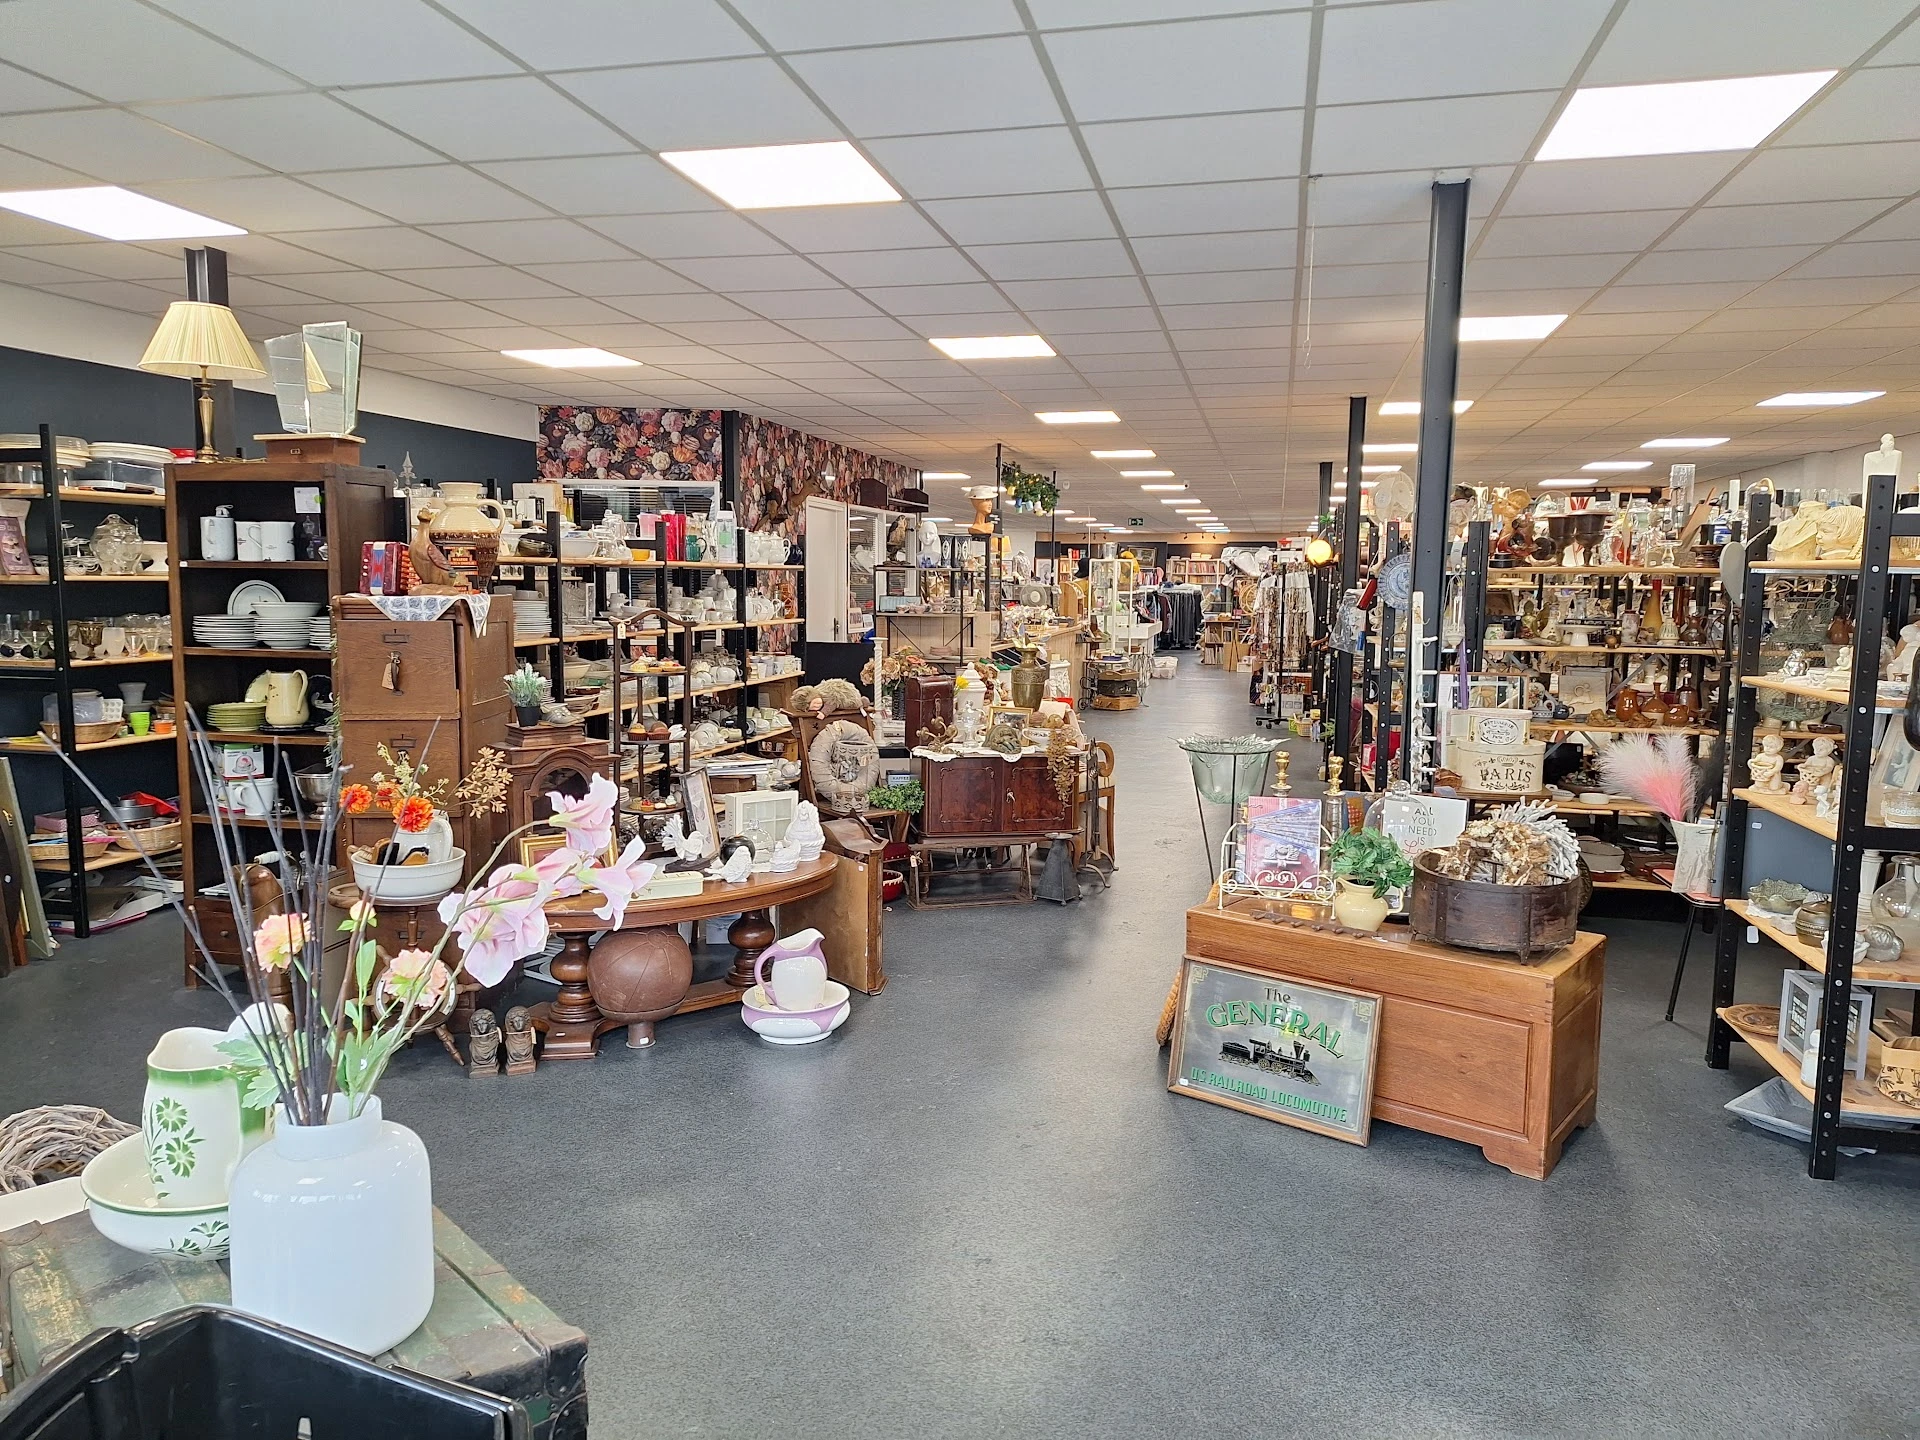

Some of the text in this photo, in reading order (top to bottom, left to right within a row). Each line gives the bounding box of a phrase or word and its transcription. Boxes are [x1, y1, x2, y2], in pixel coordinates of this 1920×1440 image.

[1480, 767, 1532, 783] PARIS
[1414, 806, 1434, 816] ALL
[1411, 816, 1435, 826] YOU
[1408, 825, 1437, 836] NEED
[1417, 836, 1426, 846] IS
[1264, 987, 1291, 1003] The
[1206, 1000, 1345, 1058] GENERAL
[1191, 1067, 1348, 1122] US RAILROAD LOCOMOTIVE
